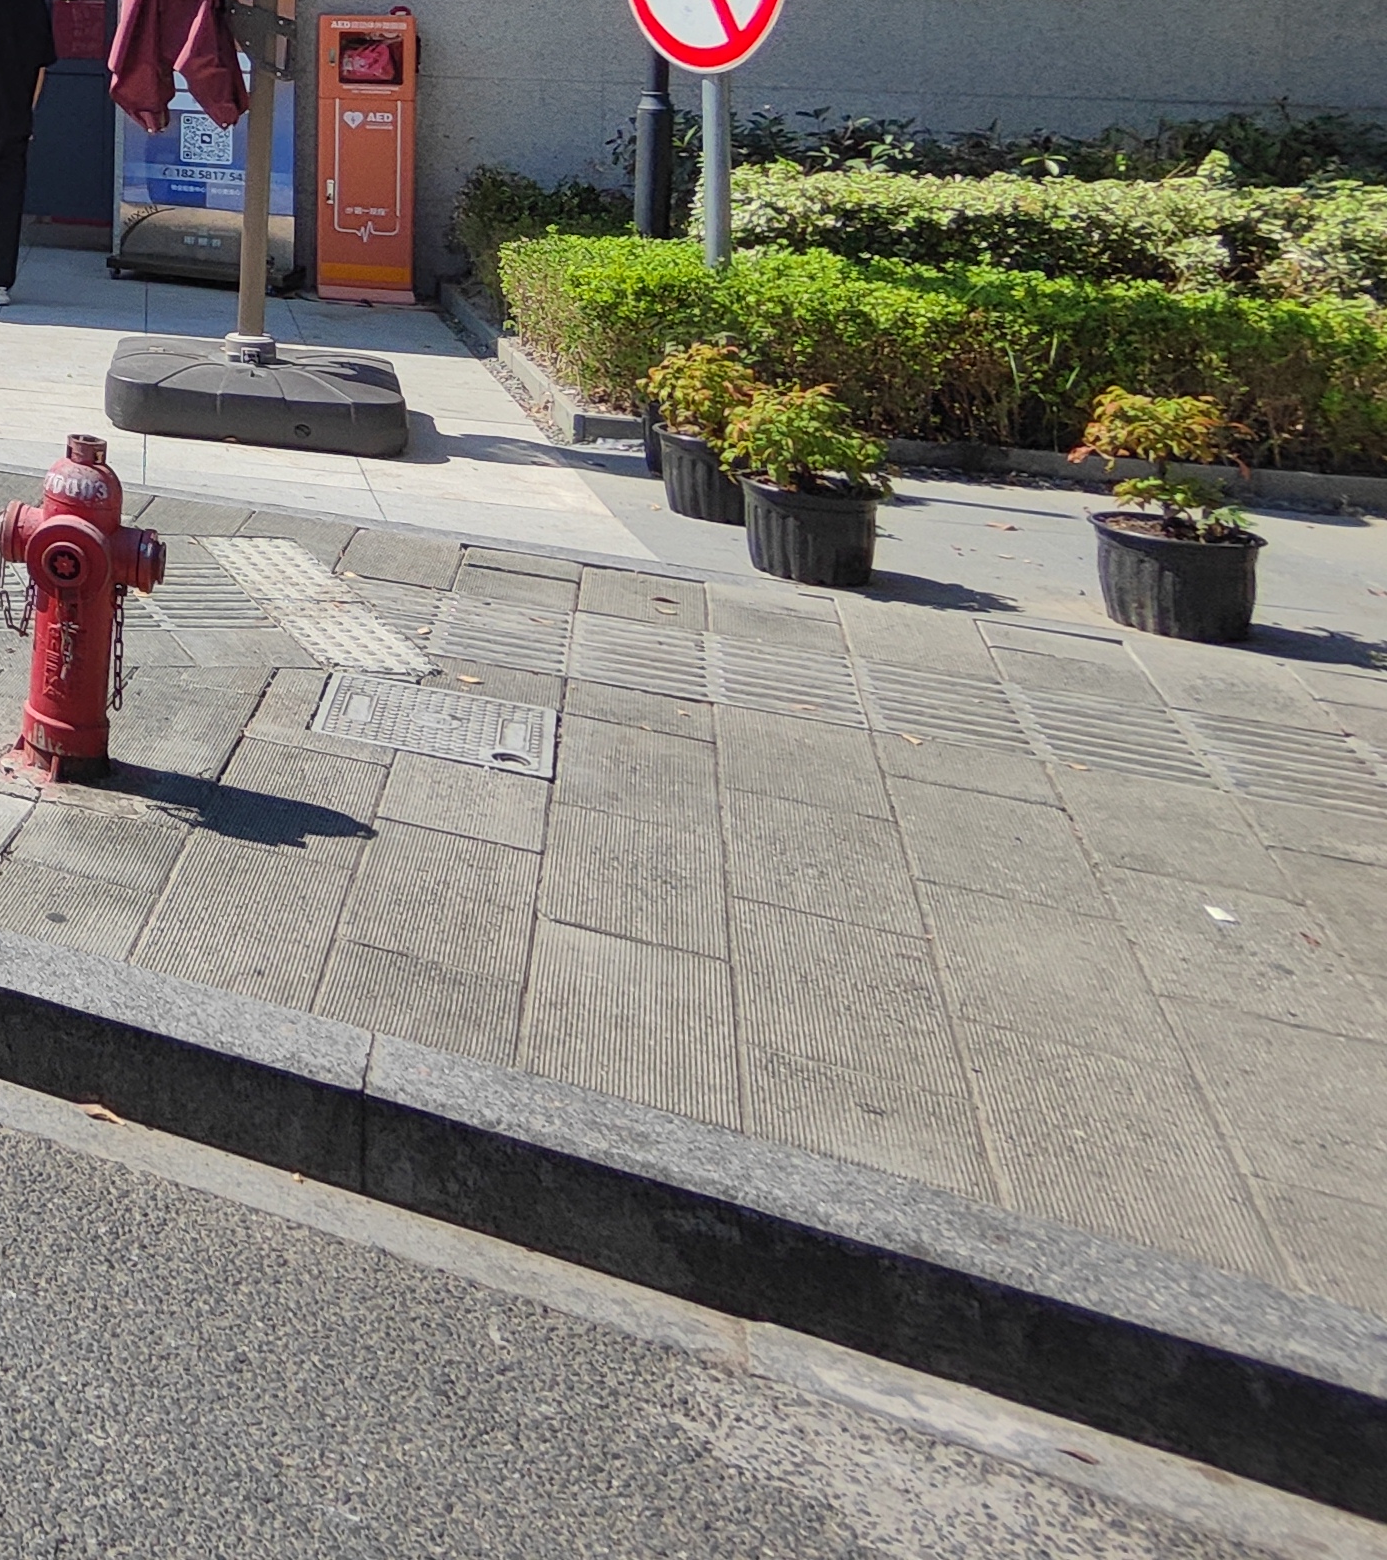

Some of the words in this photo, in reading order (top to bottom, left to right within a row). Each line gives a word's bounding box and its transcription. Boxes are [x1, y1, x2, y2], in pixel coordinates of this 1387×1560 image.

[367, 112, 393, 123] AED
[176, 168, 196, 179] 182
[198, 170, 226, 181] 5817
